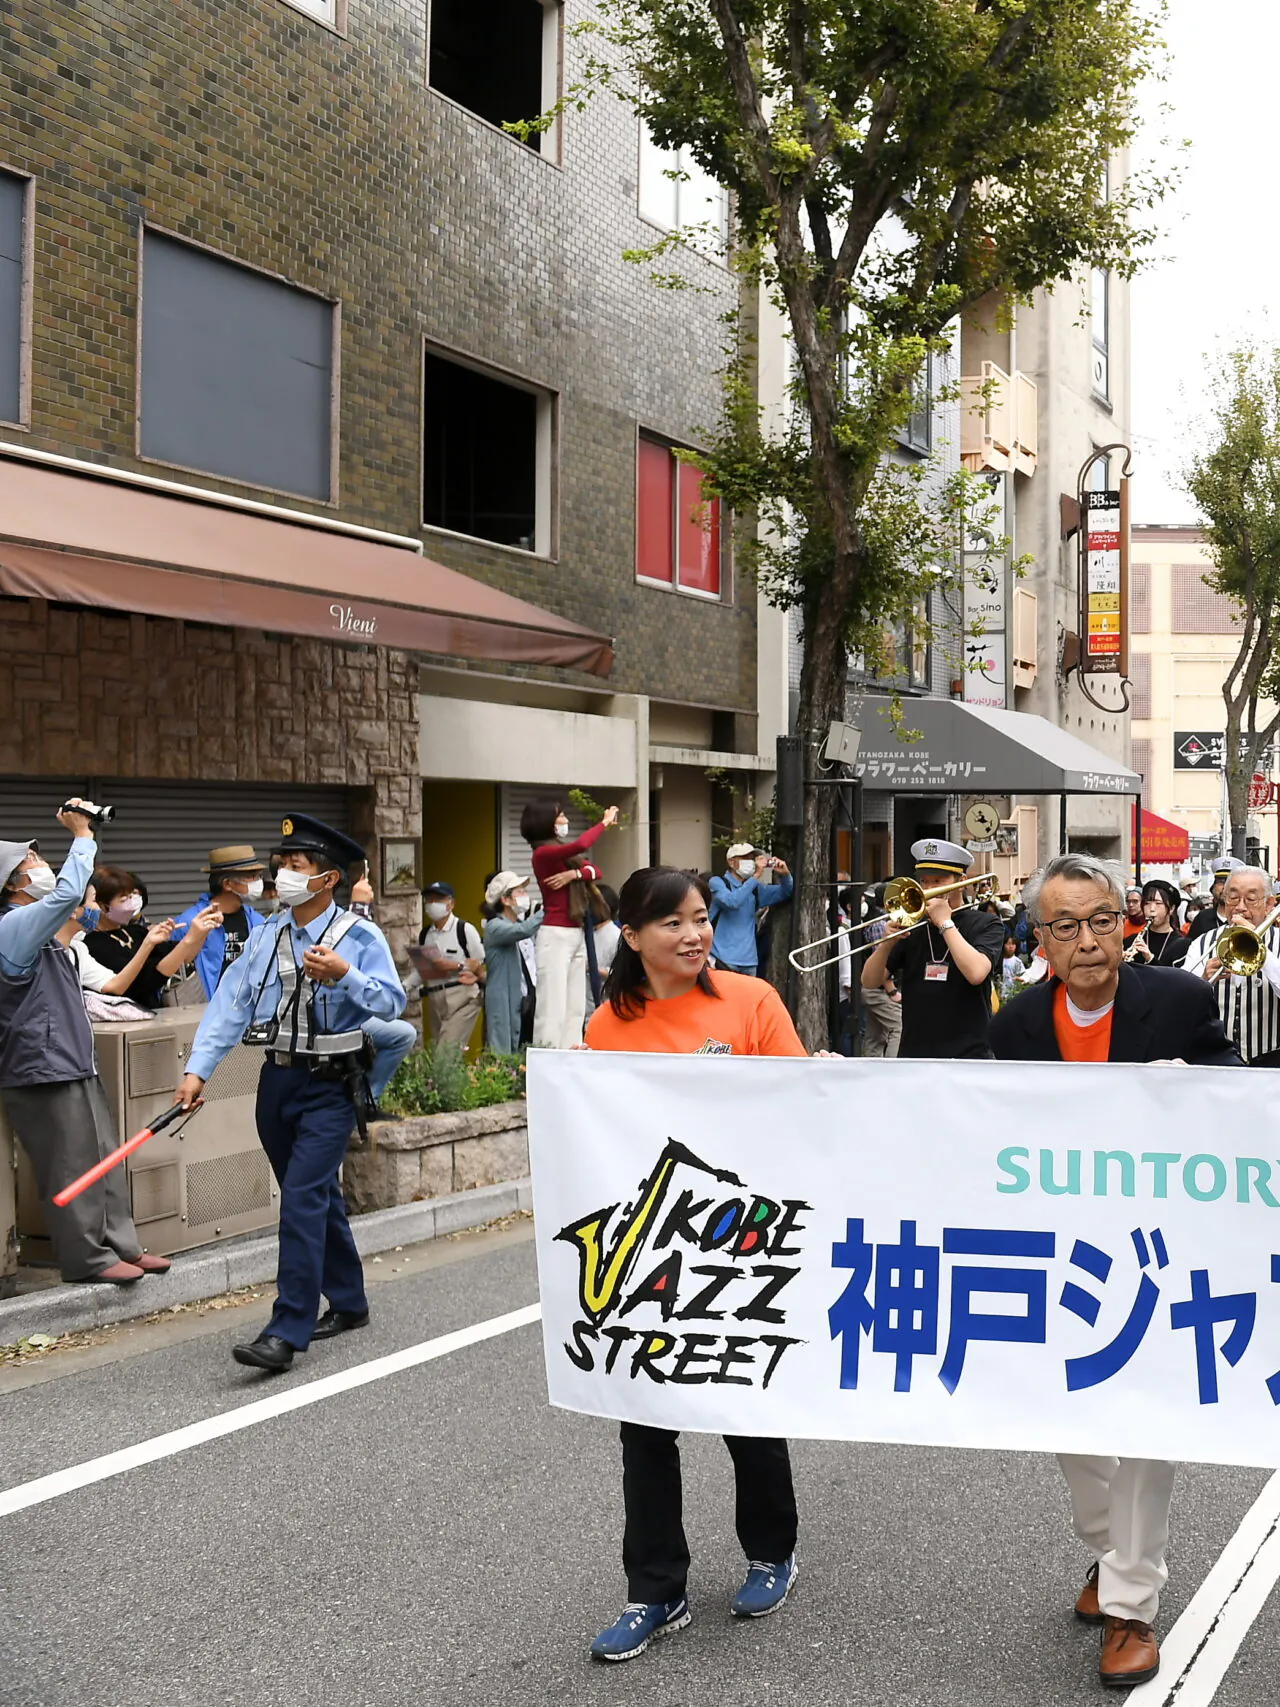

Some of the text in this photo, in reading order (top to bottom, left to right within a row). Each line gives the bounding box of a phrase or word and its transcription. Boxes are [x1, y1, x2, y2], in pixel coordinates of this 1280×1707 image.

[329, 604, 378, 634] Vieni
[856, 760, 987, 778] フラワーベーカリー
[908, 751, 930, 759] KOBE
[652, 1189, 815, 1262] KOBE
[564, 1320, 811, 1390] STREET
